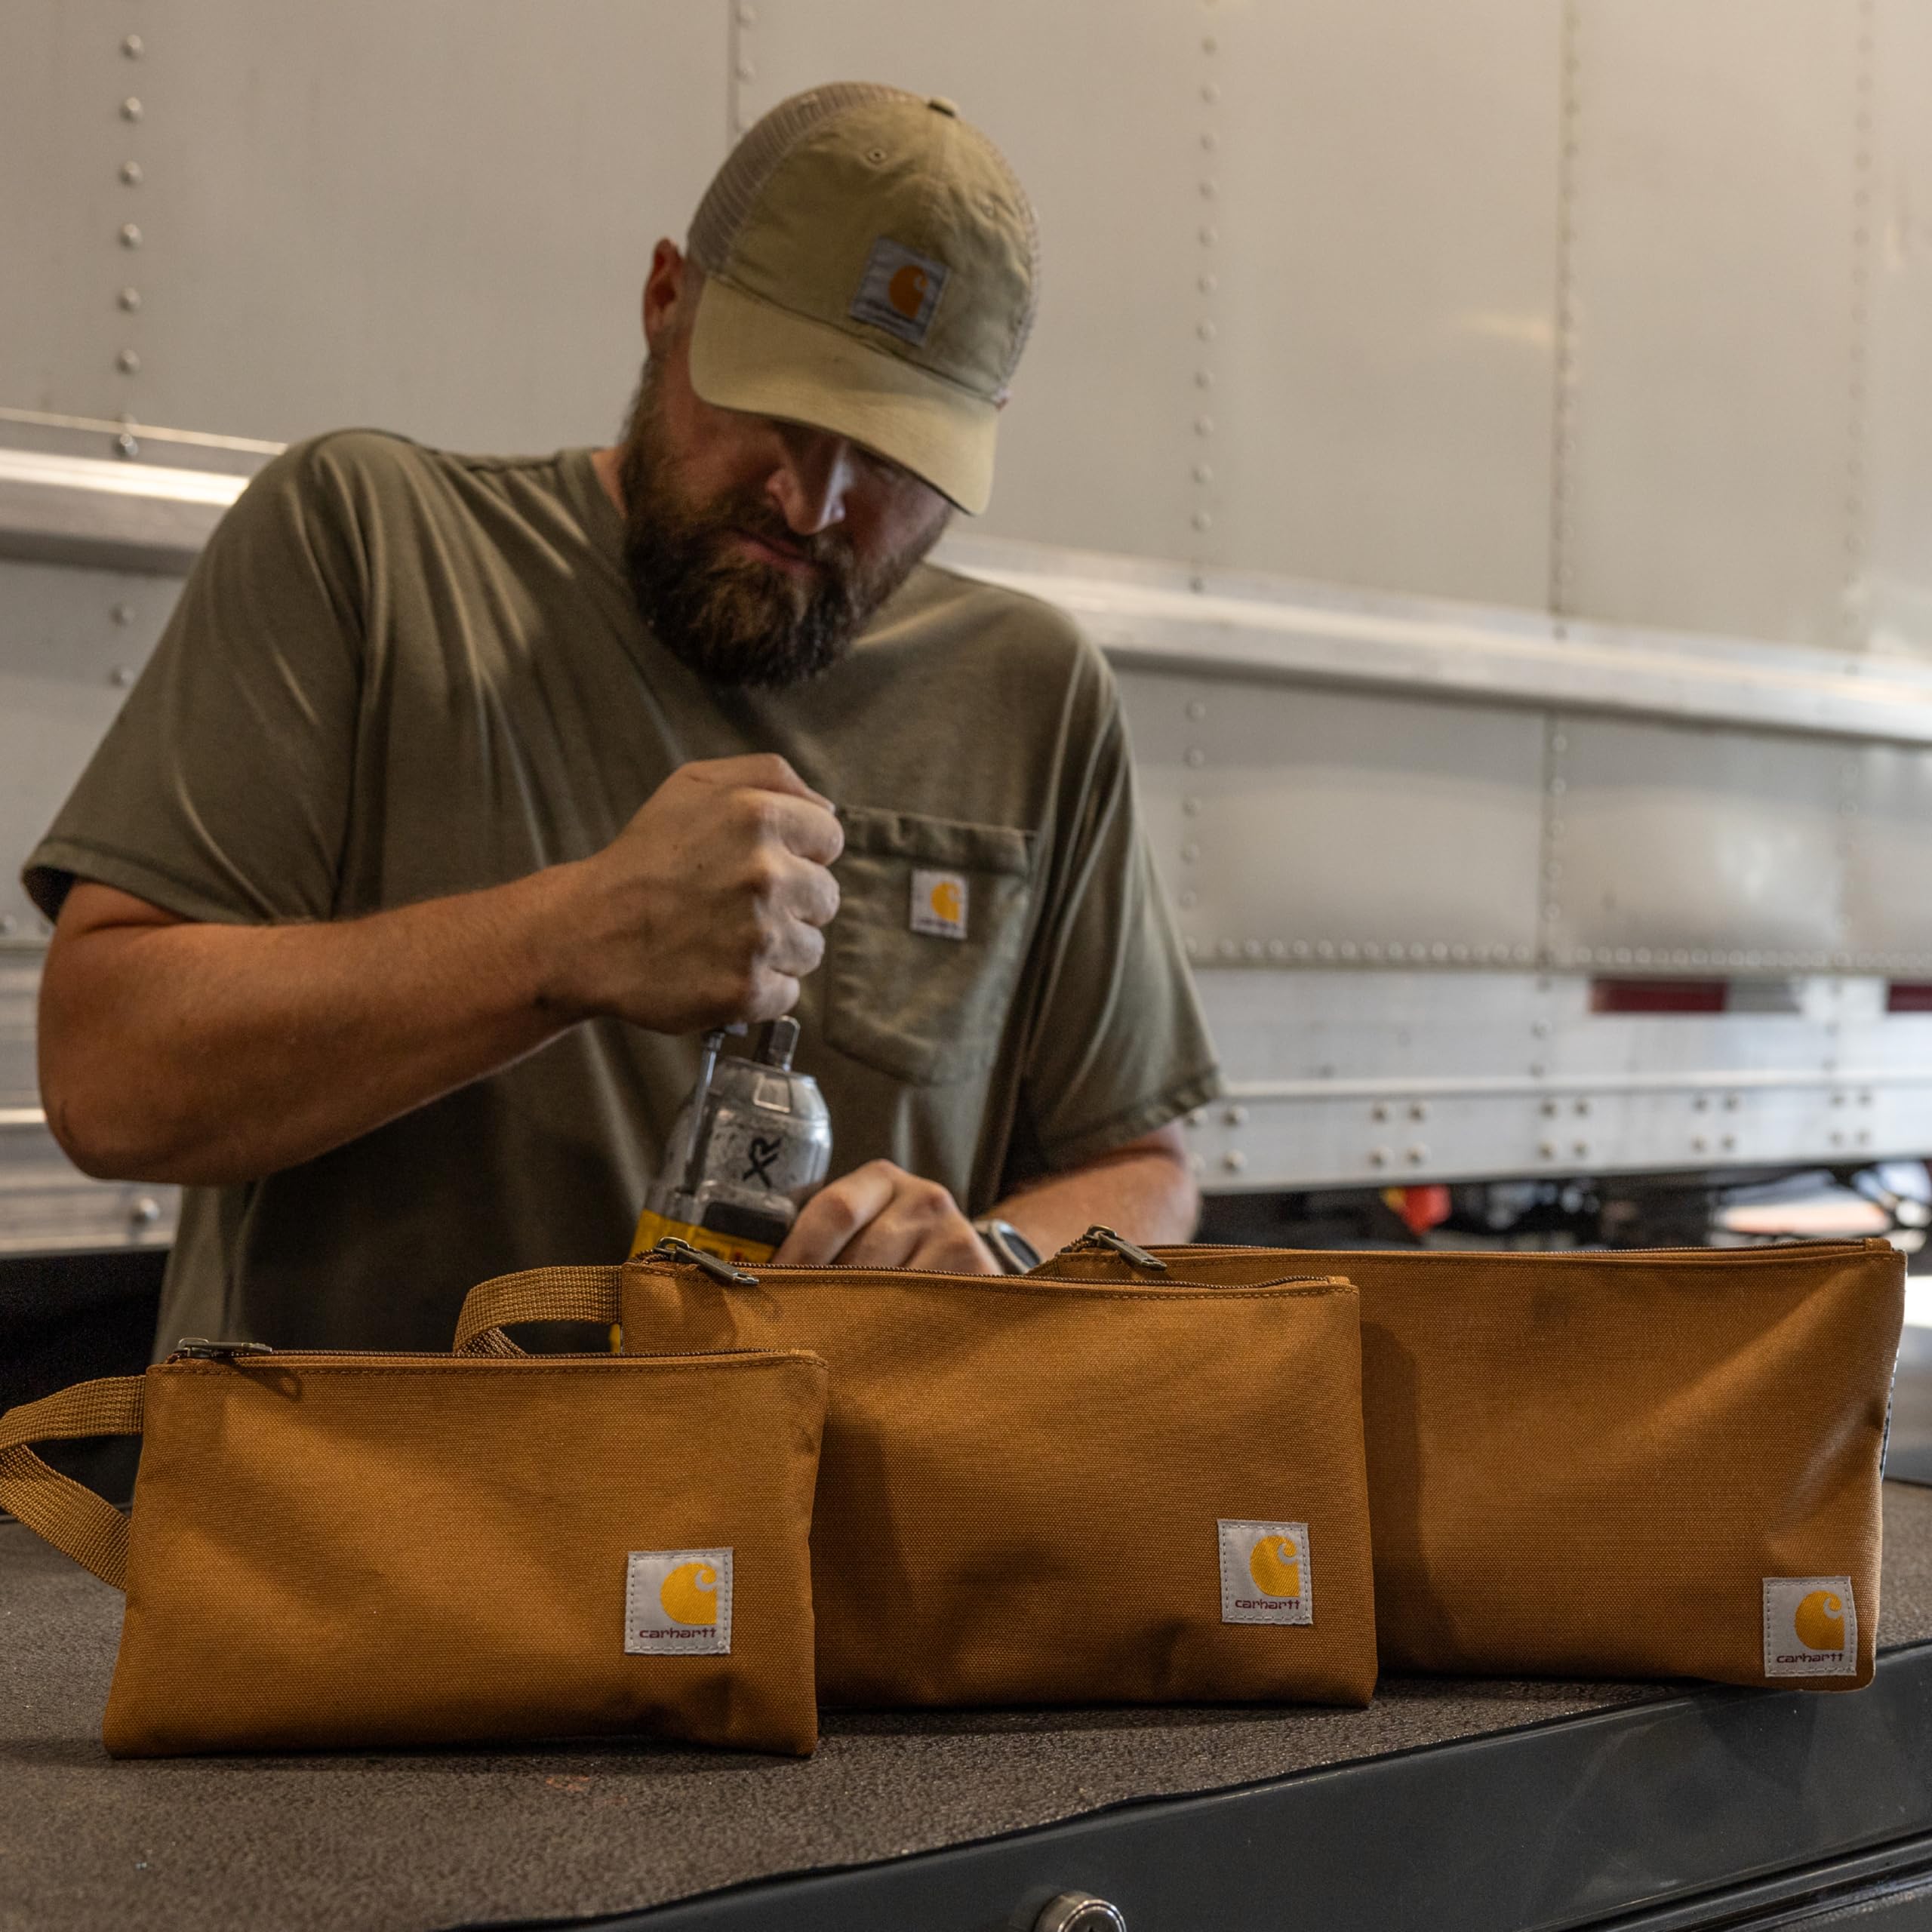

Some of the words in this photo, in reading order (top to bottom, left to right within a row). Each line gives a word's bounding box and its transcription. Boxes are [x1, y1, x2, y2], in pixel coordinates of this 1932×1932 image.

[1235, 1598, 1301, 1610] carhartt
[639, 1627, 716, 1639] carhartt
[1776, 1652, 1844, 1664] carhartt
